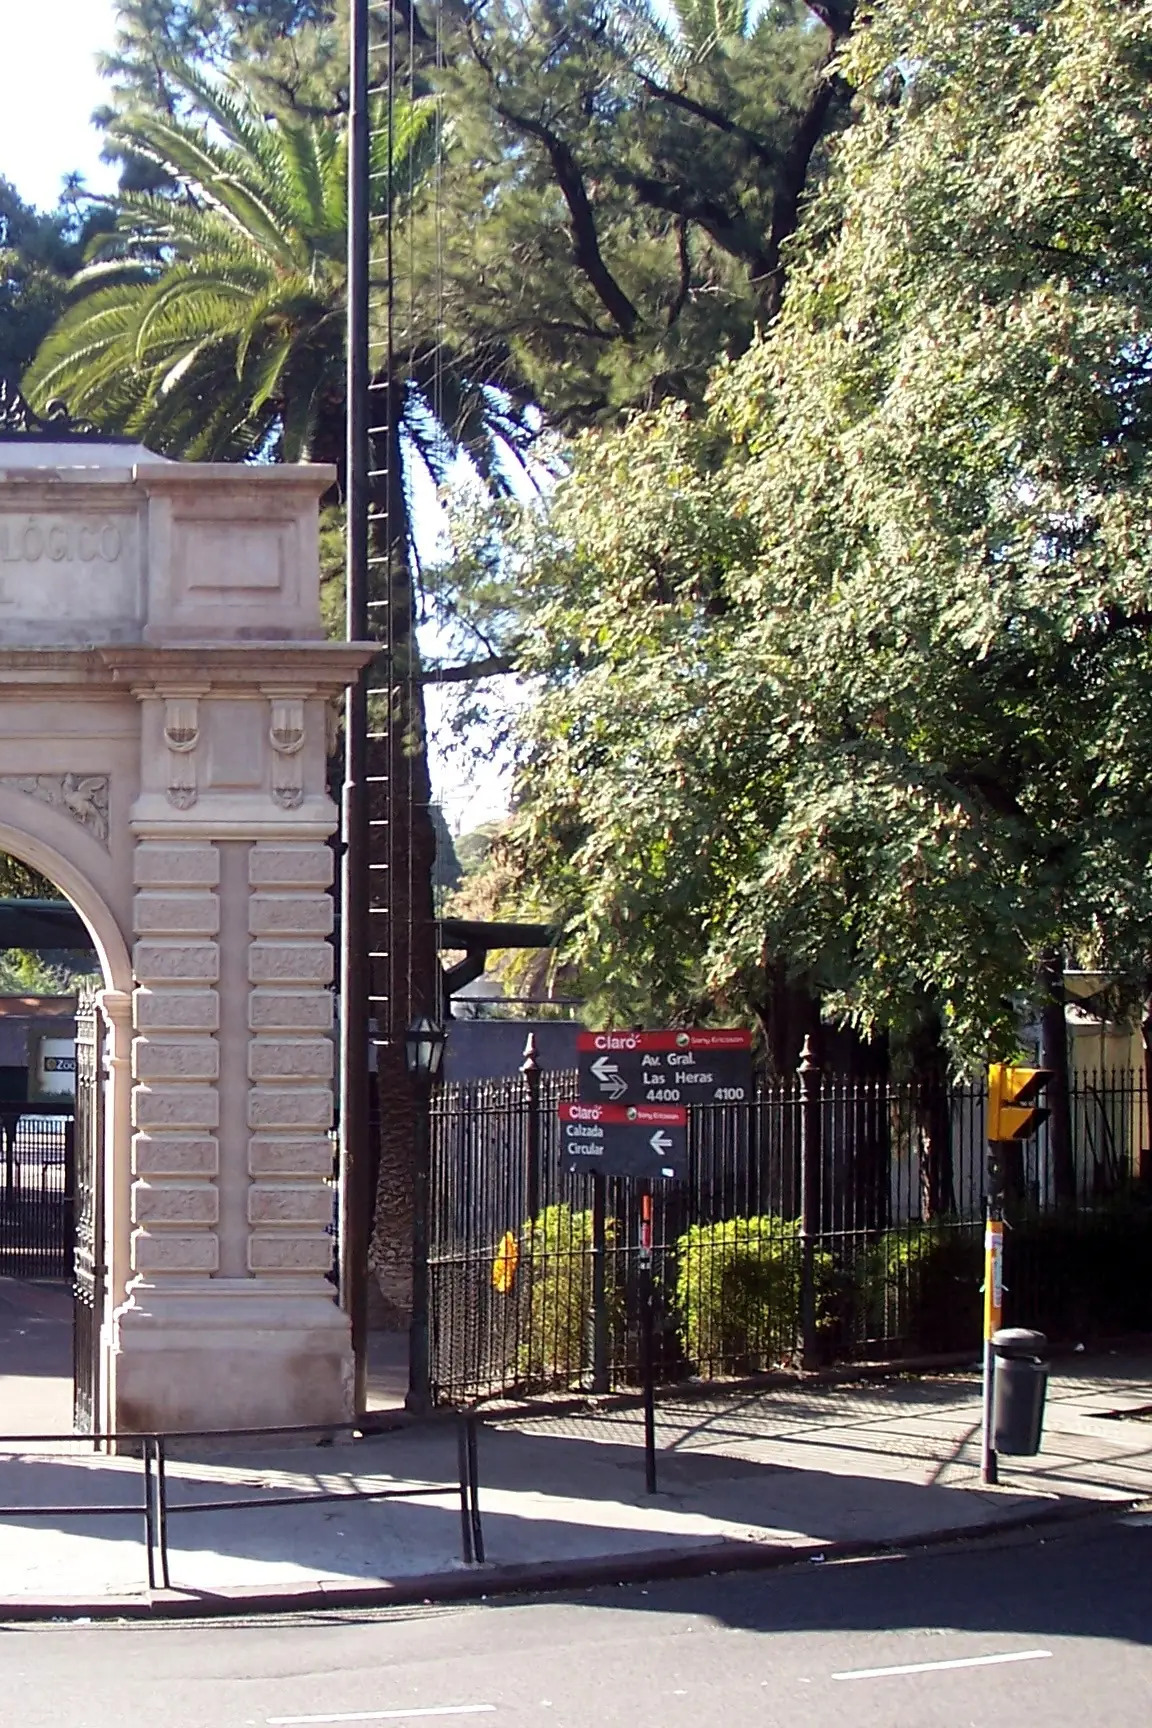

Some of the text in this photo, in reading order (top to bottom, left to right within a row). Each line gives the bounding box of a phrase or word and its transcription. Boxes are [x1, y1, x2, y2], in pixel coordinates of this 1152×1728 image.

[594, 1034, 640, 1050] Claro
[641, 1052, 696, 1066] Av. Gral.
[643, 1071, 713, 1084] Las Heras
[646, 1088, 744, 1101] 4400 4100
[569, 1105, 602, 1120] Claro
[566, 1124, 604, 1138] Calzada
[567, 1142, 604, 1156] Circular
